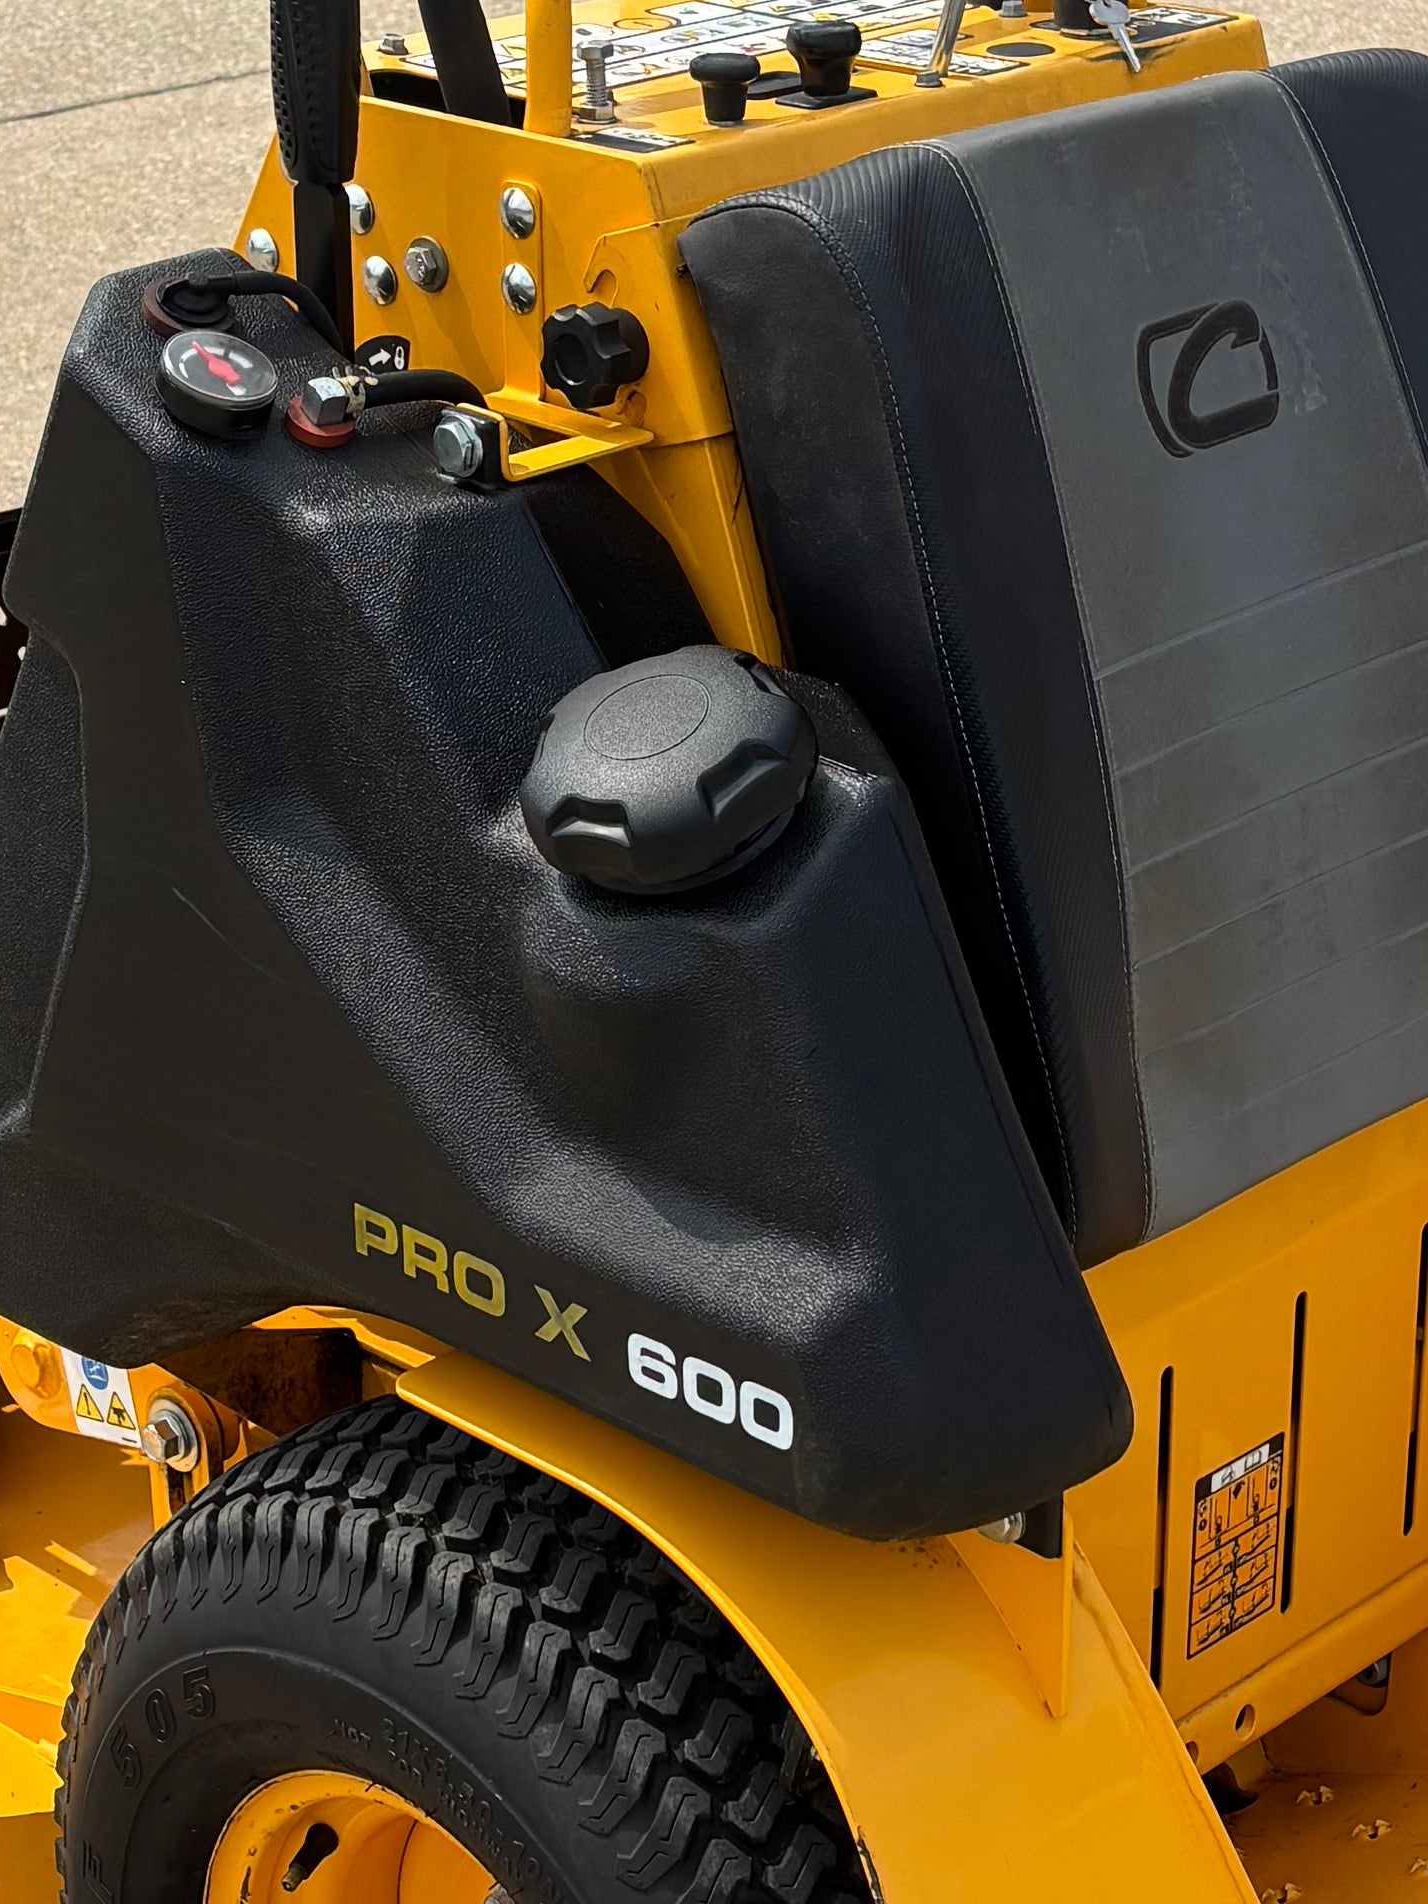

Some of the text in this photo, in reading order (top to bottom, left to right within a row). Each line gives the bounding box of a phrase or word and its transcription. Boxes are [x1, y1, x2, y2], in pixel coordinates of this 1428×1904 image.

[353, 1201, 795, 1452] PRO X 600
[109, 1664, 217, 1791] 505
[334, 1718, 372, 1748] NOT
